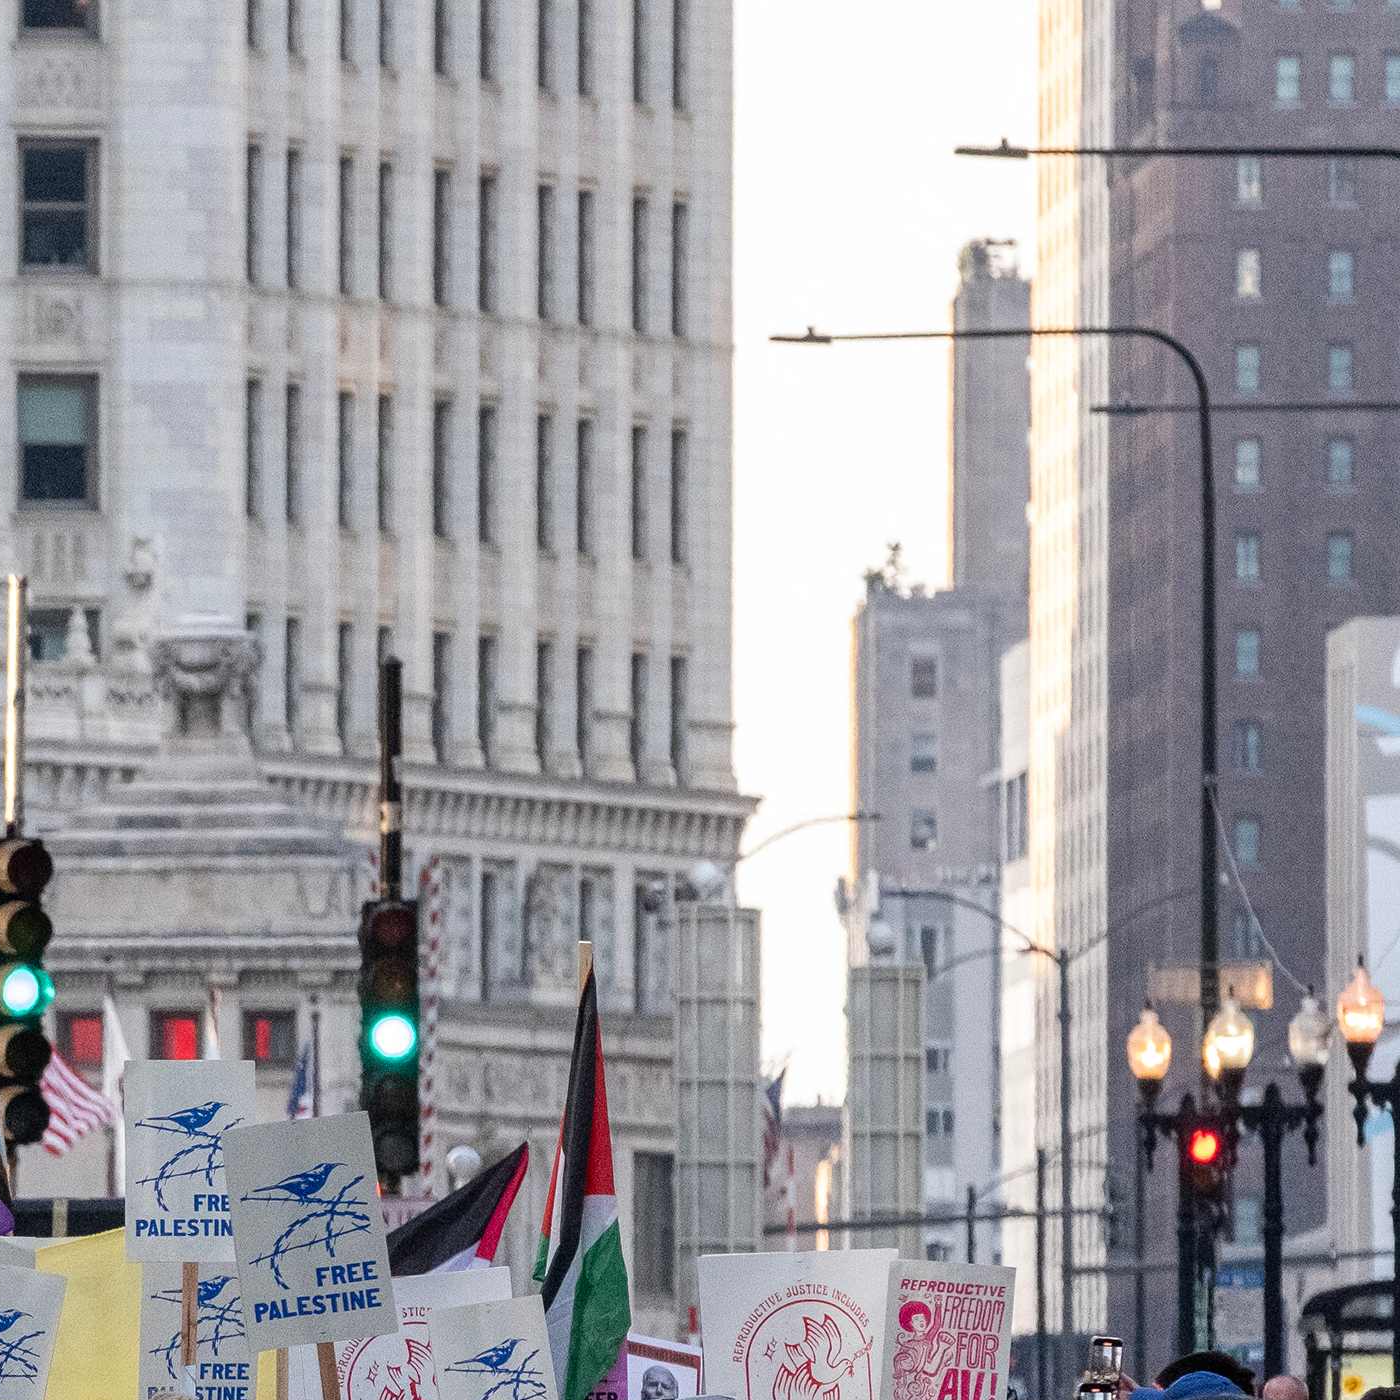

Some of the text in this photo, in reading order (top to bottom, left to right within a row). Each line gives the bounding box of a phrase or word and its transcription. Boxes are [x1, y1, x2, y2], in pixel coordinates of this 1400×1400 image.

[193, 1194, 230, 1212] FRE
[135, 1219, 234, 1237] PALESTIN
[316, 1260, 378, 1287] FREE
[900, 1278, 1006, 1297] REPRODUCTIVE
[254, 1288, 382, 1323] PALESTINE
[941, 1295, 1006, 1333] FREEDOM
[733, 1292, 783, 1363] REPRODUCTIVE
[785, 1284, 829, 1298] JUSTICE
[831, 1287, 870, 1328] INCLUDES
[955, 1332, 999, 1370] FOR
[200, 1363, 250, 1380] FREE
